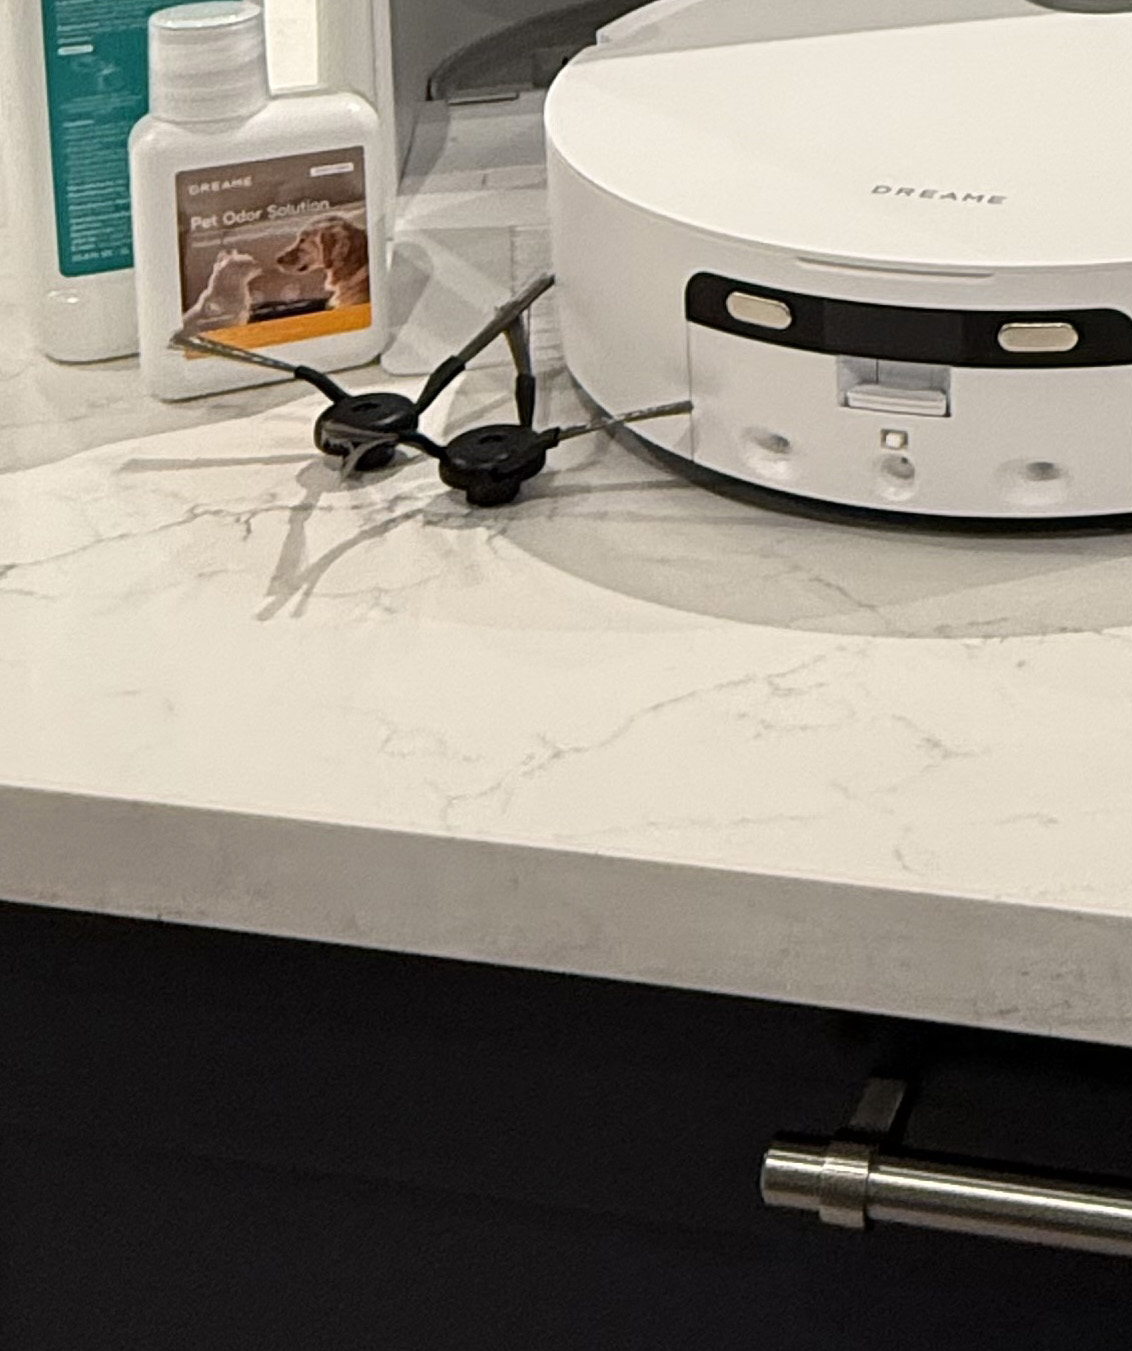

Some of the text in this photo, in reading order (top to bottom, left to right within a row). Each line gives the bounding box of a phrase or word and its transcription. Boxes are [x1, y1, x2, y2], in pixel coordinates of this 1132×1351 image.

[188, 176, 252, 195] DREAME
[871, 185, 1007, 204] DREAME
[190, 199, 330, 231] Pet Odor Solution
